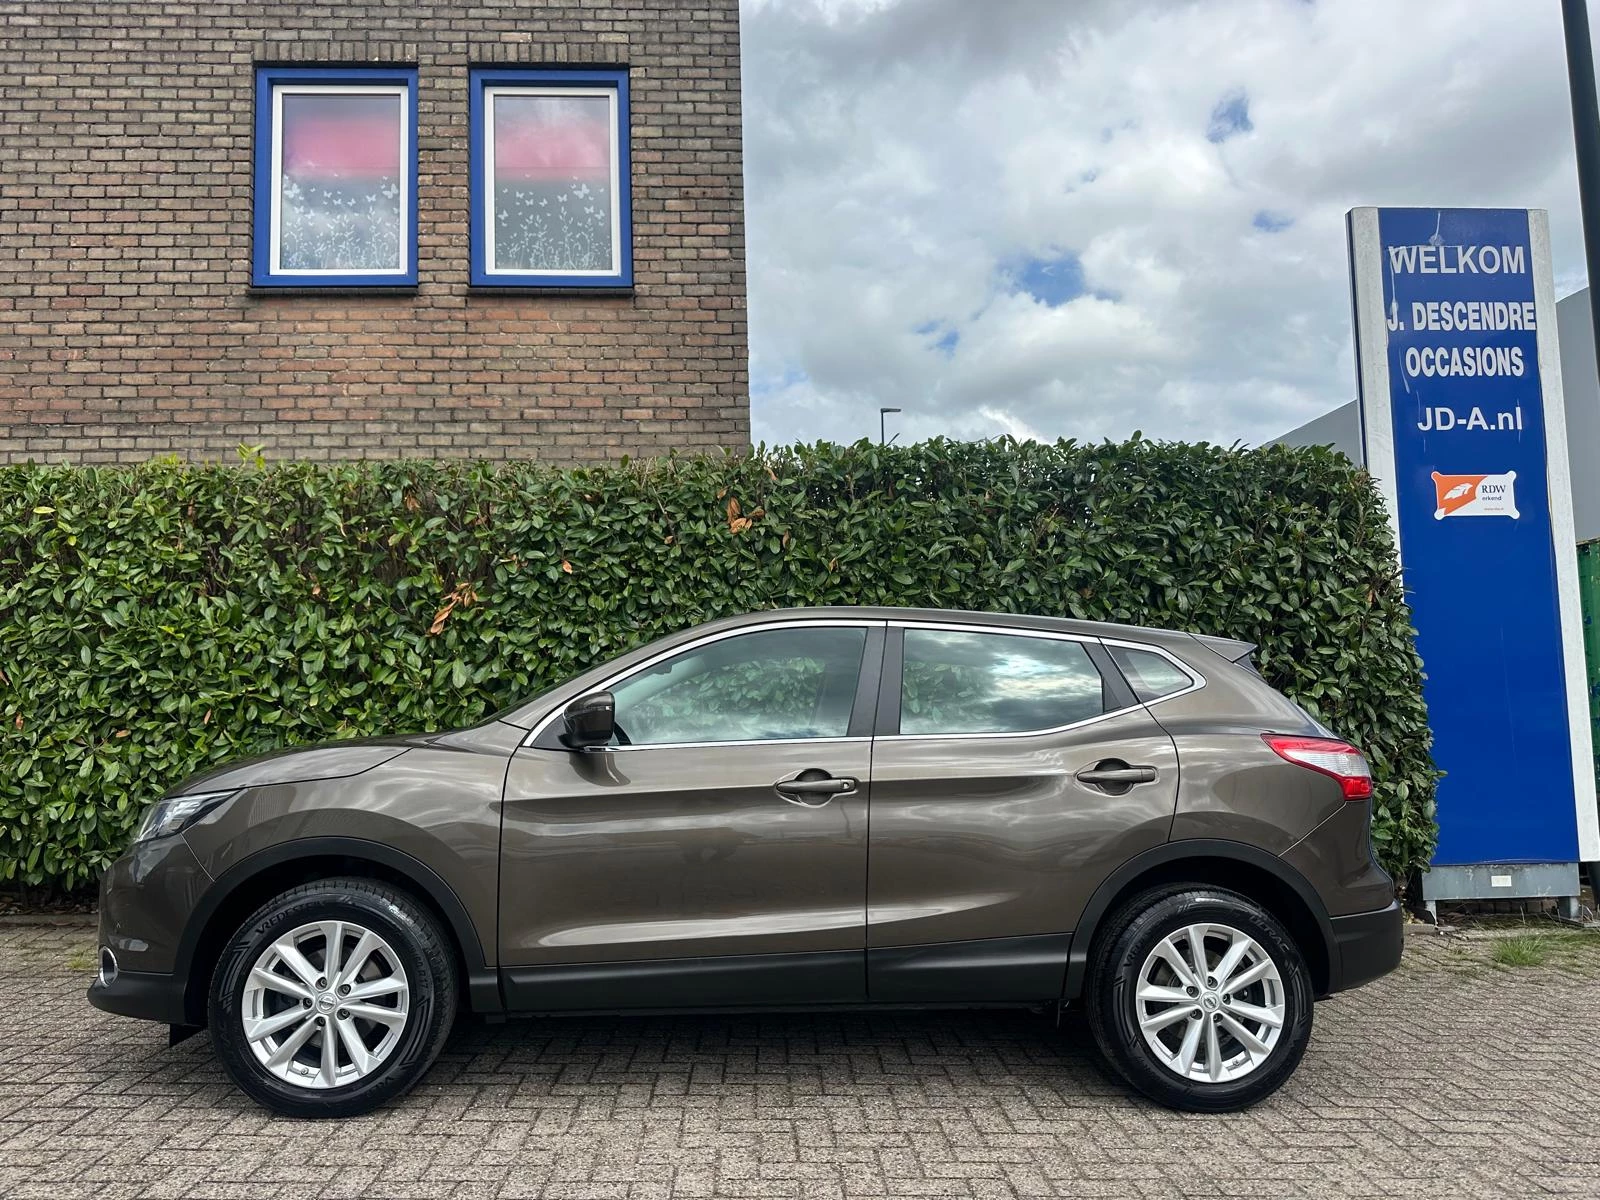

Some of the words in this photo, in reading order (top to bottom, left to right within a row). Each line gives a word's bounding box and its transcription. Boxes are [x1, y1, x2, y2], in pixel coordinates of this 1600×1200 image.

[1388, 245, 1525, 274] WELKOM
[1387, 303, 1404, 331] J.
[1412, 301, 1537, 331] DESCENDRE
[1405, 347, 1524, 377] OCCASIONS
[1417, 407, 1523, 431] JD-A.nl
[1482, 485, 1506, 493] RDW
[255, 900, 326, 935] VREDESTE
